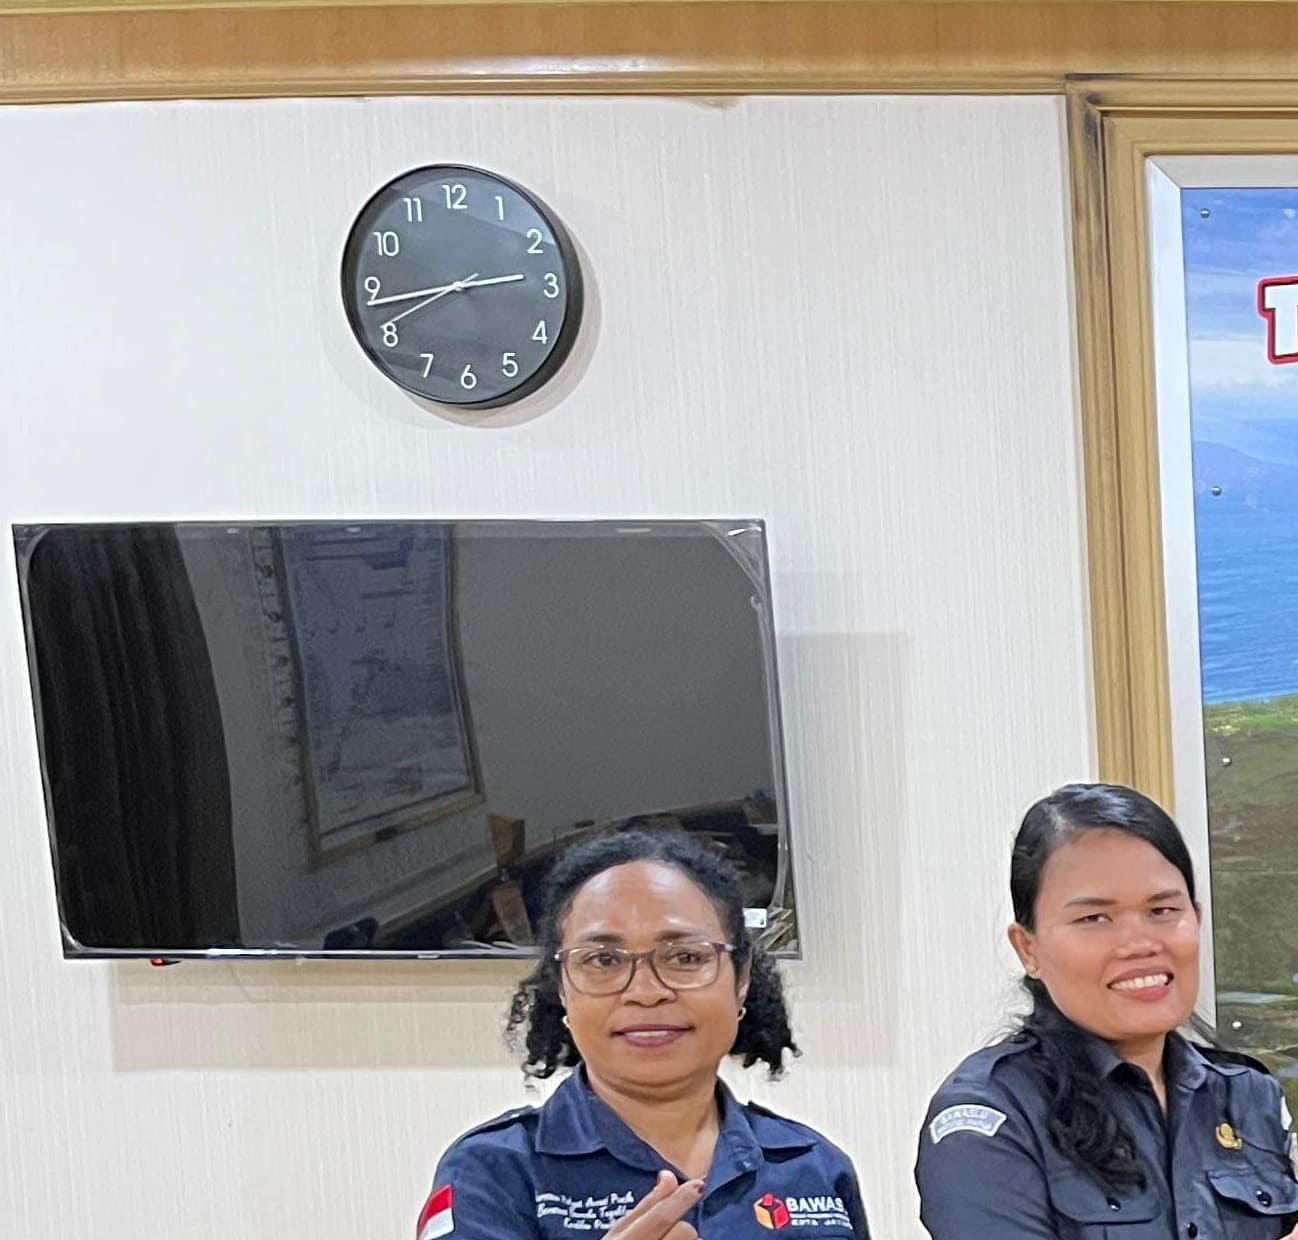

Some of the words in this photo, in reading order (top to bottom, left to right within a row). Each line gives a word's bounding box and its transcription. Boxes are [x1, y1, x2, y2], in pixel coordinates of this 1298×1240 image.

[442, 184, 467, 209] 12
[495, 196, 504, 220] 1
[403, 197, 422, 222] 11
[373, 231, 400, 256] 10
[526, 229, 543, 254] 2
[364, 276, 380, 300] 9
[543, 273, 559, 298] 3
[383, 322, 398, 347] 8
[532, 320, 548, 344] 4
[420, 354, 434, 378] 7
[460, 364, 477, 389] 6
[502, 353, 519, 377] 5
[786, 1196, 848, 1215] BAWAS
